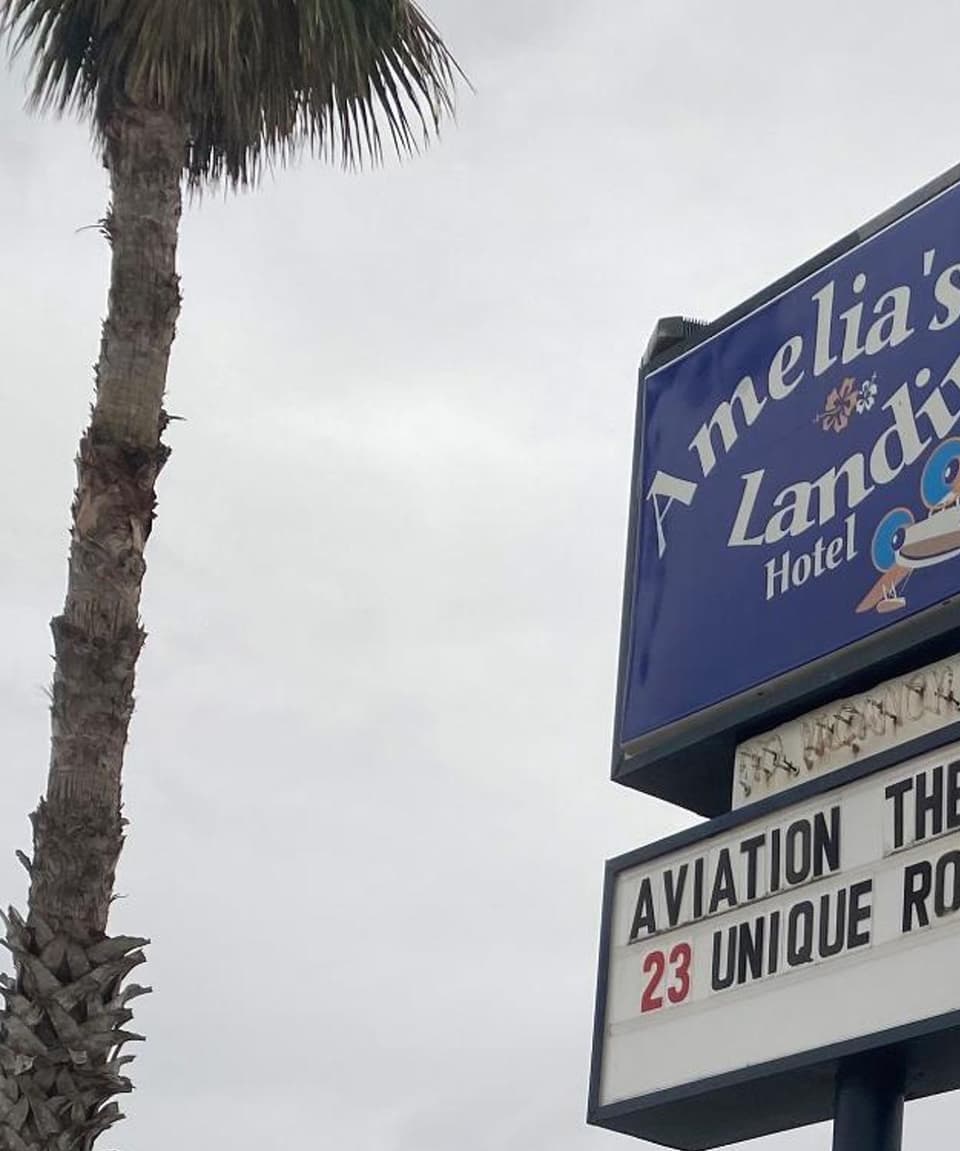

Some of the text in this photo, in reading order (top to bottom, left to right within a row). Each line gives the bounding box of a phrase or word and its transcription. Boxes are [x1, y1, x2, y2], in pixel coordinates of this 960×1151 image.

[764, 513, 857, 600] Hotel
[629, 806, 841, 940] AVIATION
[640, 943, 692, 1014] 23
[711, 878, 873, 992] UNIQUE
